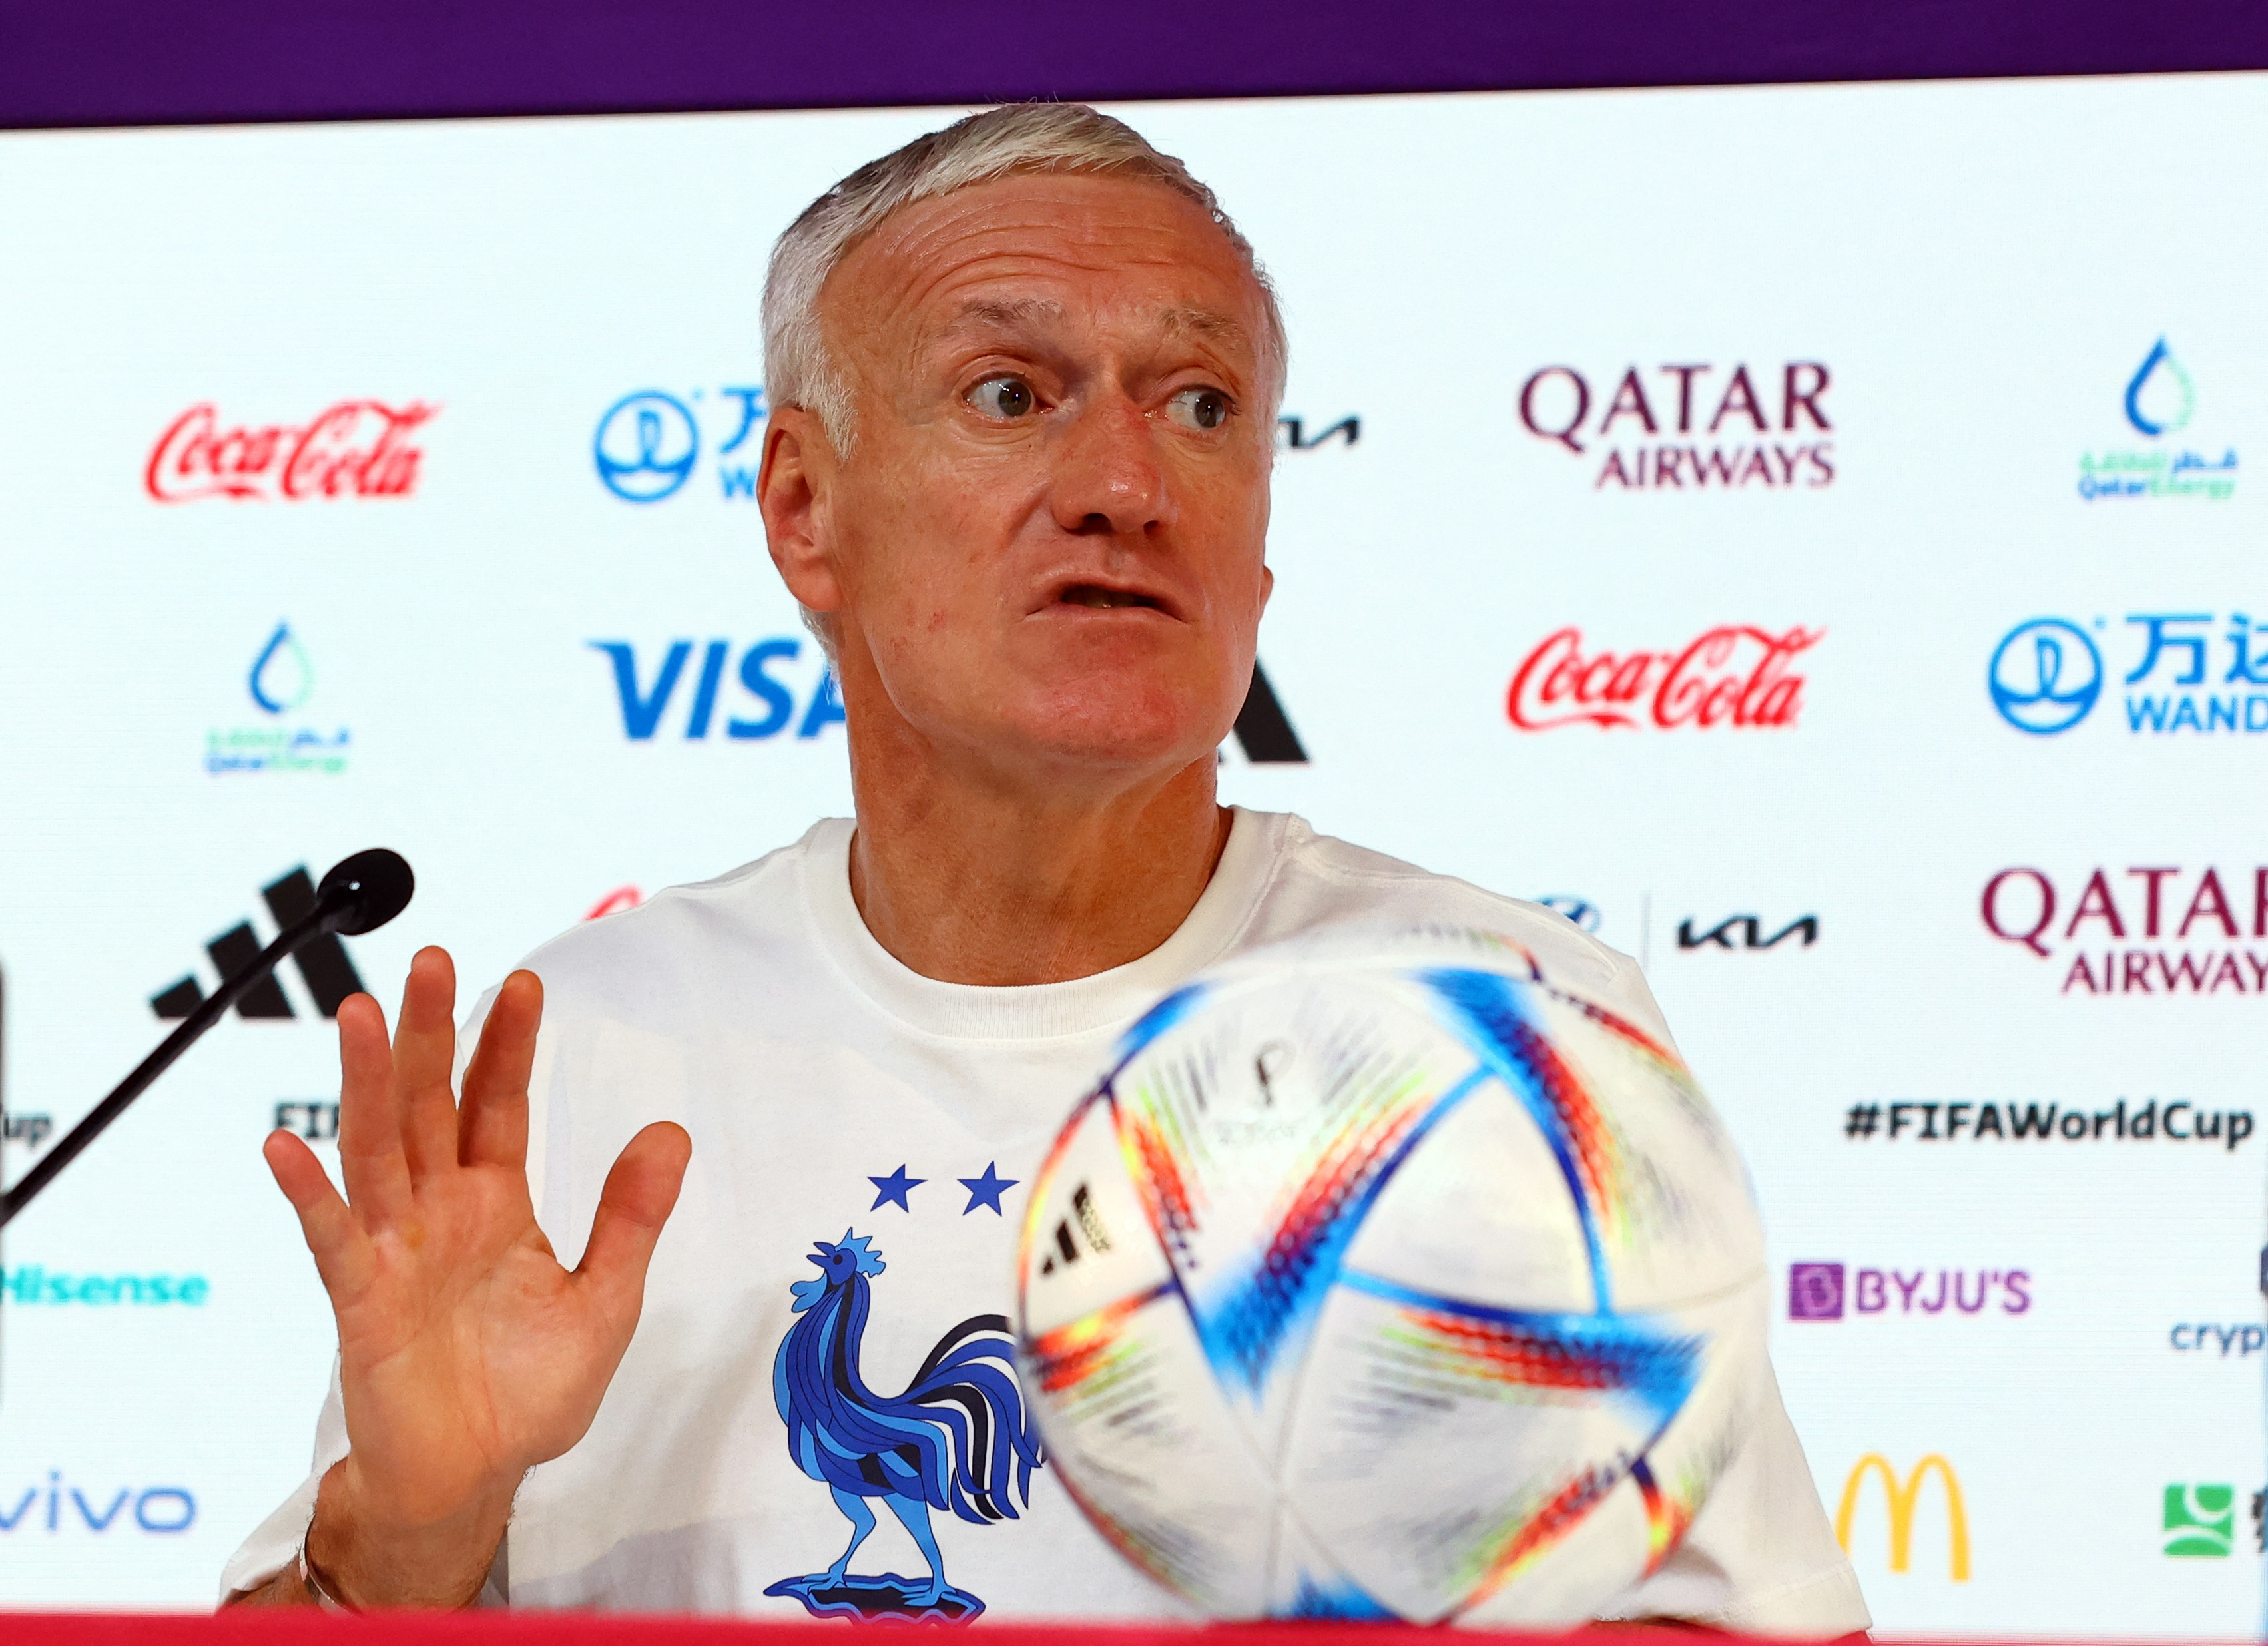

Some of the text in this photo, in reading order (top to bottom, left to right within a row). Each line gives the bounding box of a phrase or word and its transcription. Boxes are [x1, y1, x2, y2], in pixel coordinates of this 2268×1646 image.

[1518, 362, 1833, 455] QATAR
[143, 401, 436, 503] Coca-Cola
[1599, 445, 1834, 487] AIRWAYS
[1506, 626, 1827, 730] Coca-Cola
[1676, 913, 1819, 951] KIA
[1980, 866, 2268, 958] QATA
[1844, 1099, 2255, 1152] #FIFAWorldCup
[0, 1265, 209, 1306] Hisense
[1855, 1268, 2030, 1314] BYJU'S
[0, 1470, 197, 1533] vivo
